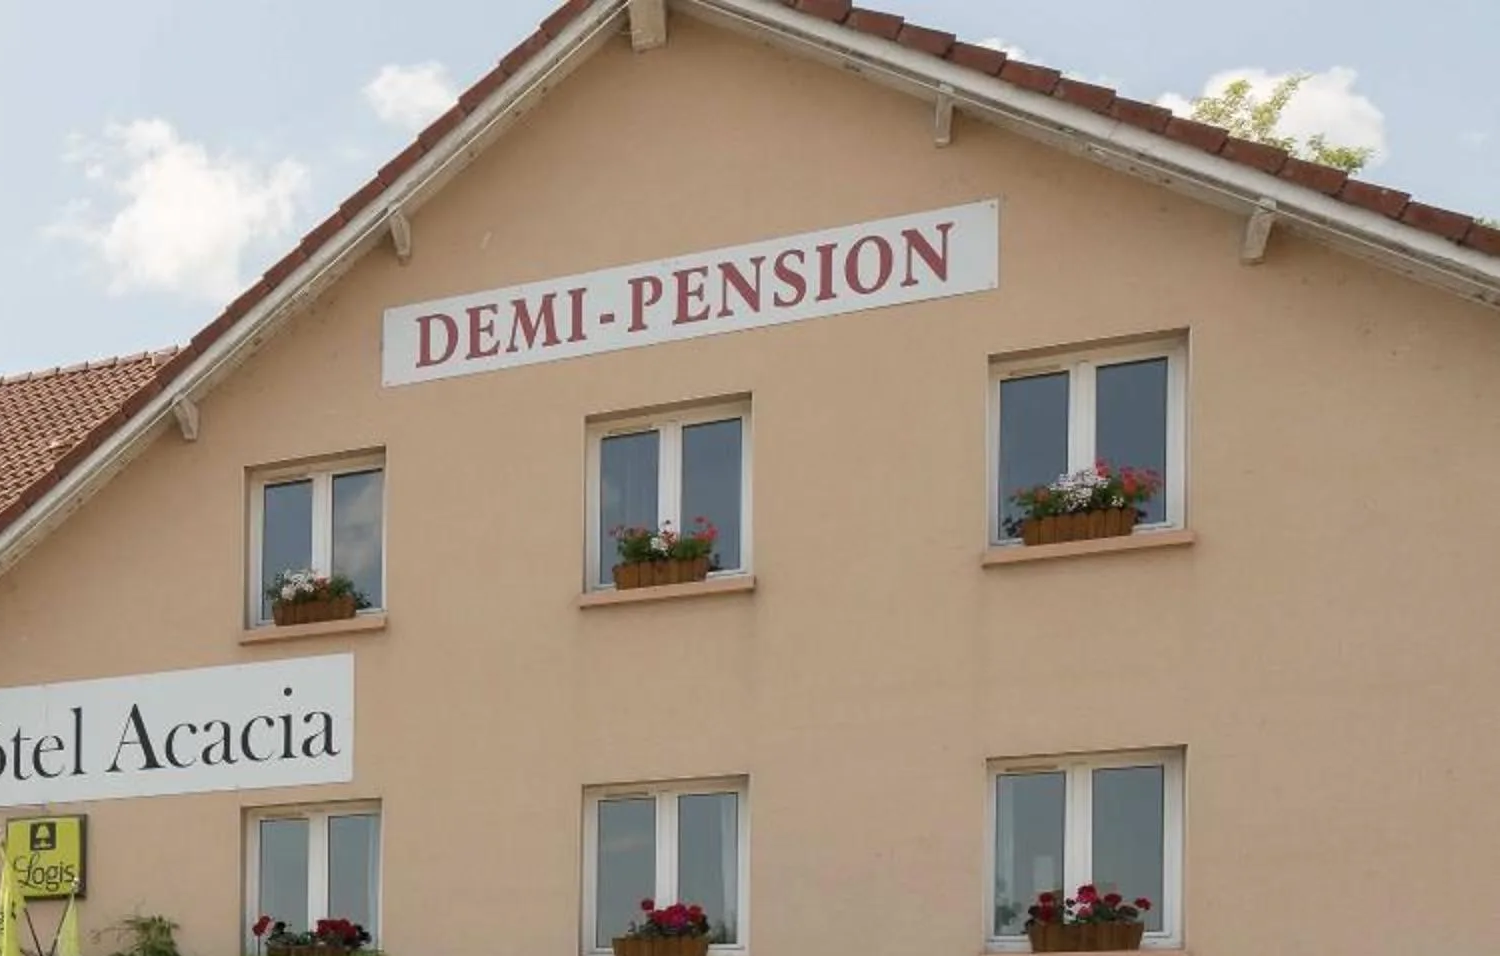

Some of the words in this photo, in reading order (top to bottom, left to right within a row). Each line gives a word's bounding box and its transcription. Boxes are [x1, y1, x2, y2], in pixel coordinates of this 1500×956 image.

[416, 222, 954, 367] DEMI-PENSION
[105, 687, 340, 772] Acacia
[13, 853, 76, 891] Logis
